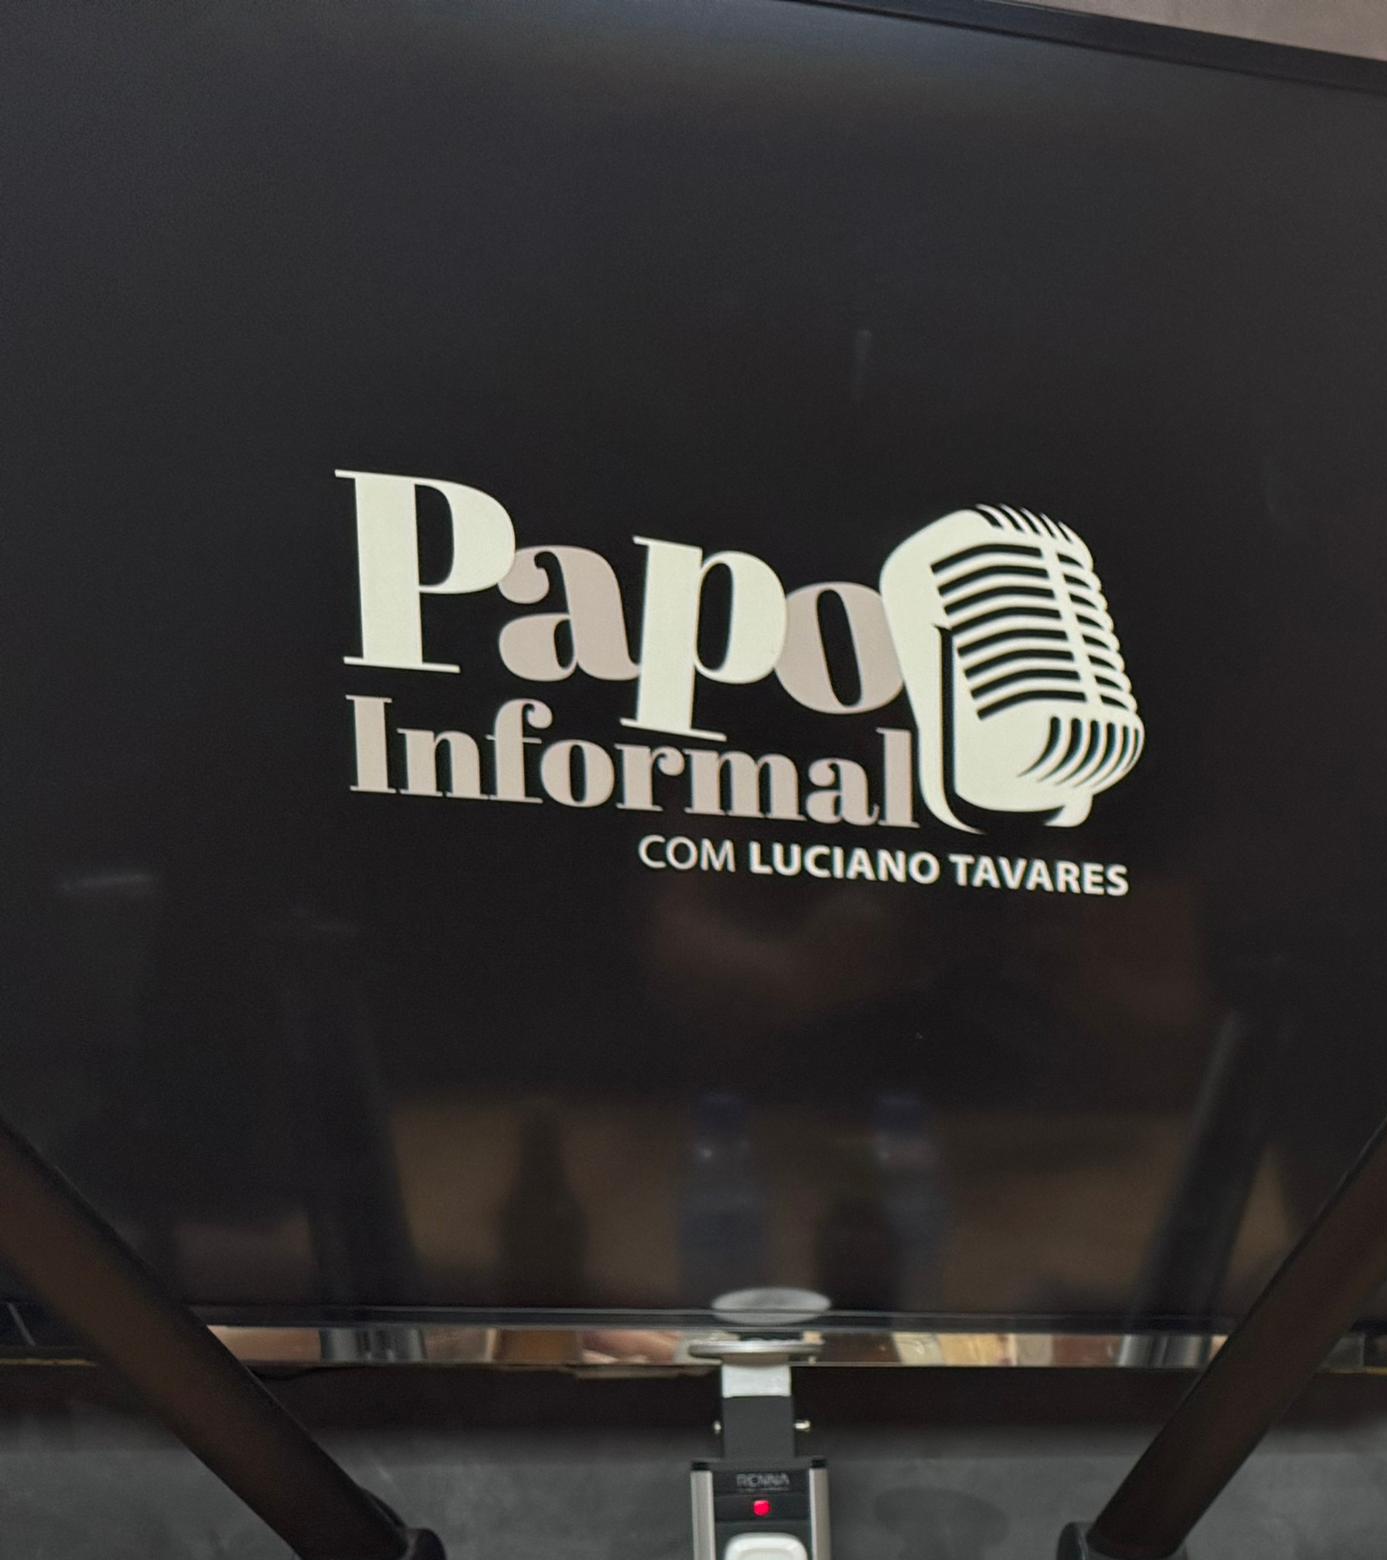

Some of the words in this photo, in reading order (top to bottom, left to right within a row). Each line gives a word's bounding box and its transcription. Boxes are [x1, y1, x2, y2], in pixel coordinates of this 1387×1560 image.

[334, 469, 906, 741] Papo
[344, 694, 920, 829] Informal
[638, 834, 736, 873] COM
[748, 840, 940, 886] LUCIANO
[949, 852, 1129, 897] TAVARES
